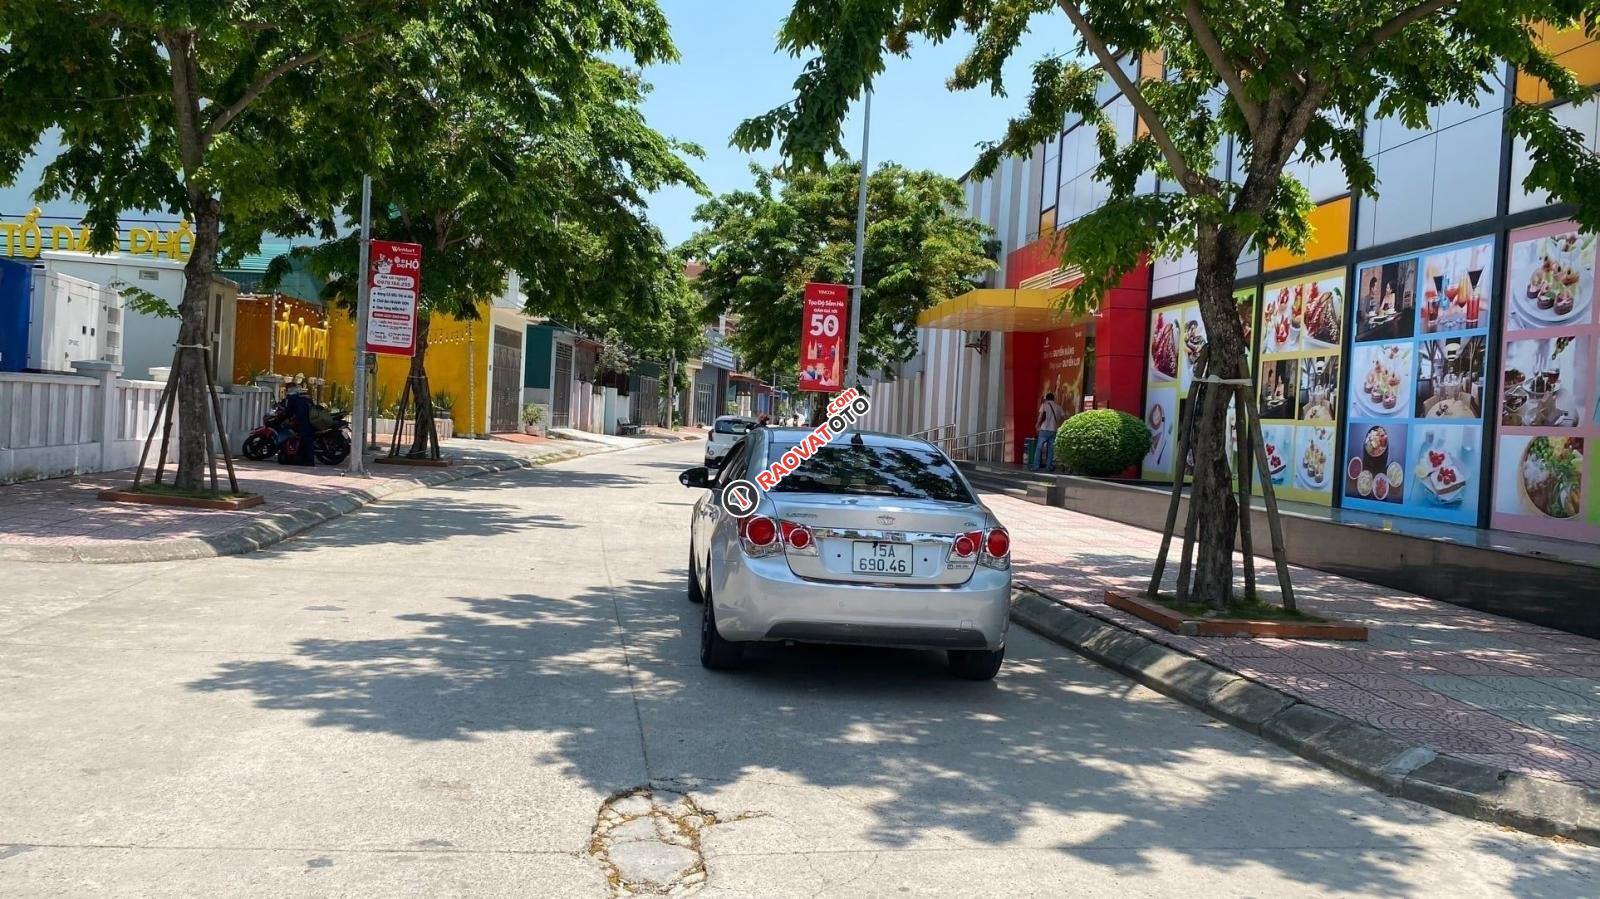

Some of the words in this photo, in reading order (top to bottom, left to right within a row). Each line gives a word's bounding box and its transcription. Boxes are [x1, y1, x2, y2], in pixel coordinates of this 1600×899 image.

[0, 206, 43, 258] TỔ
[872, 544, 896, 558] 15A
[859, 558, 906, 572] 690.46
